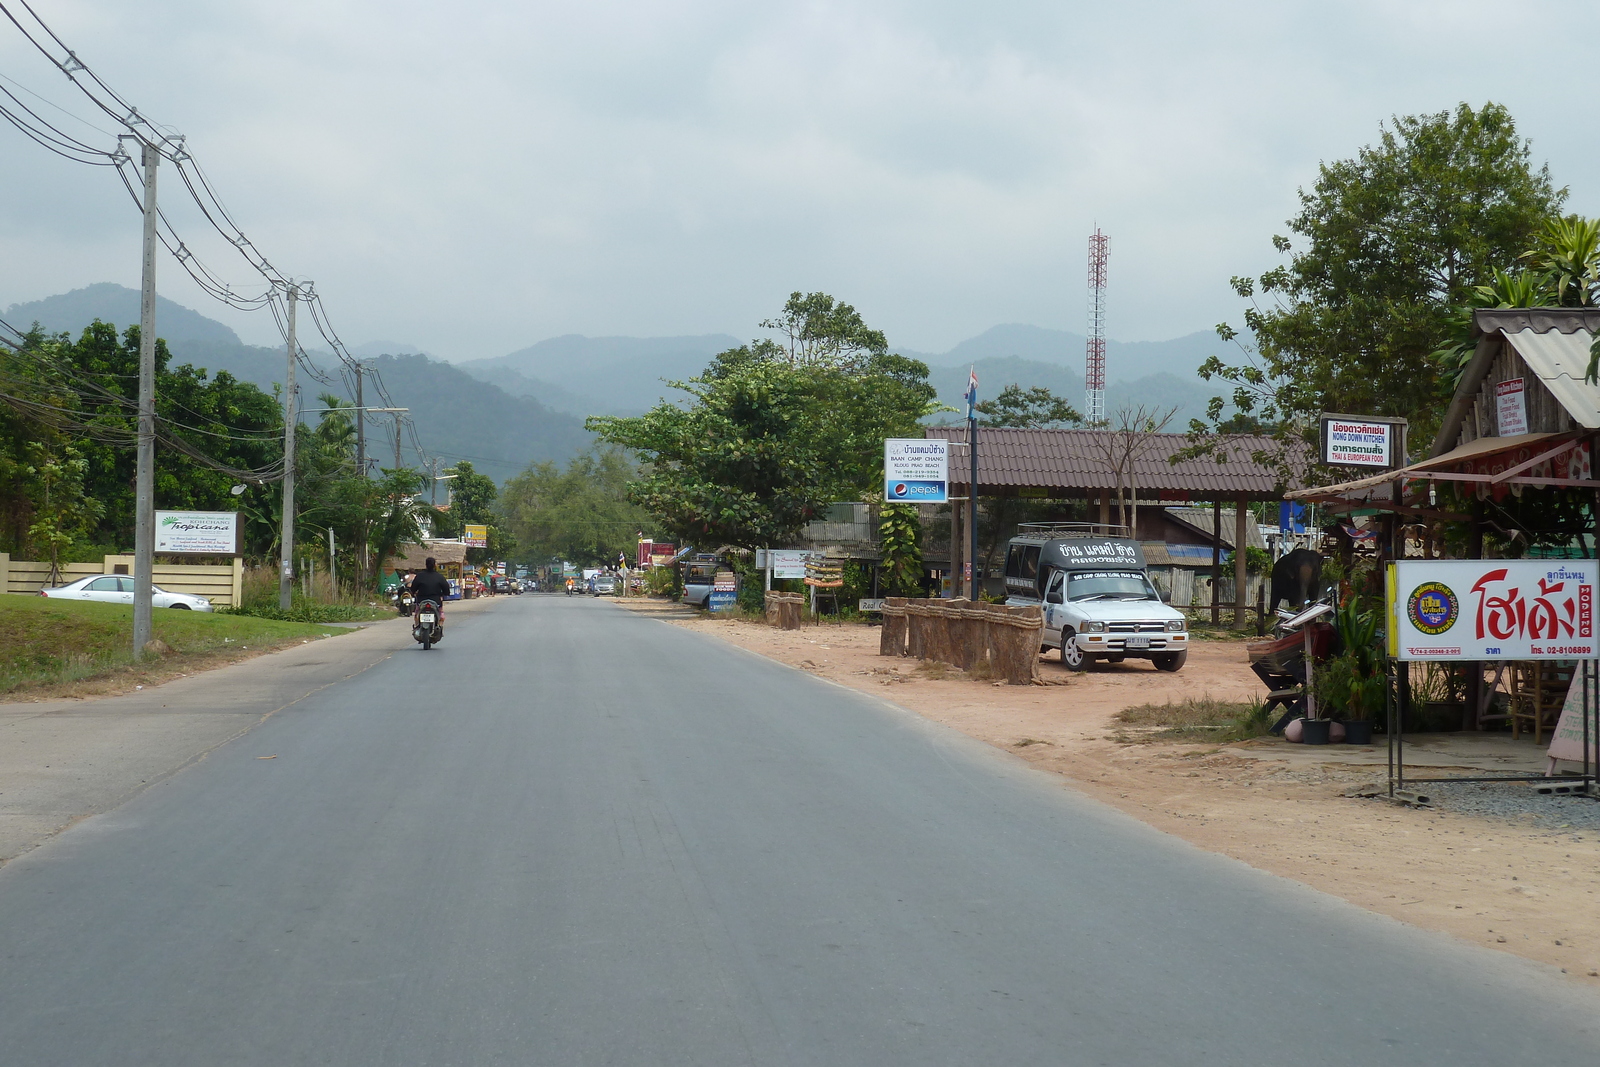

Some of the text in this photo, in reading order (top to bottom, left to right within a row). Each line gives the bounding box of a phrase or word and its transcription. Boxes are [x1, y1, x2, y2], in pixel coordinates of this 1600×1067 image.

[1333, 433, 1385, 443] NONG DOWN KITCHEN
[1333, 444, 1383, 454] อาหารตามสั่ง
[910, 485, 939, 495] pepsi
[171, 522, 229, 531] Tropicana
[1547, 566, 1584, 583] ลูกชิ้นหมู
[1531, 644, 1544, 654] โทร.
